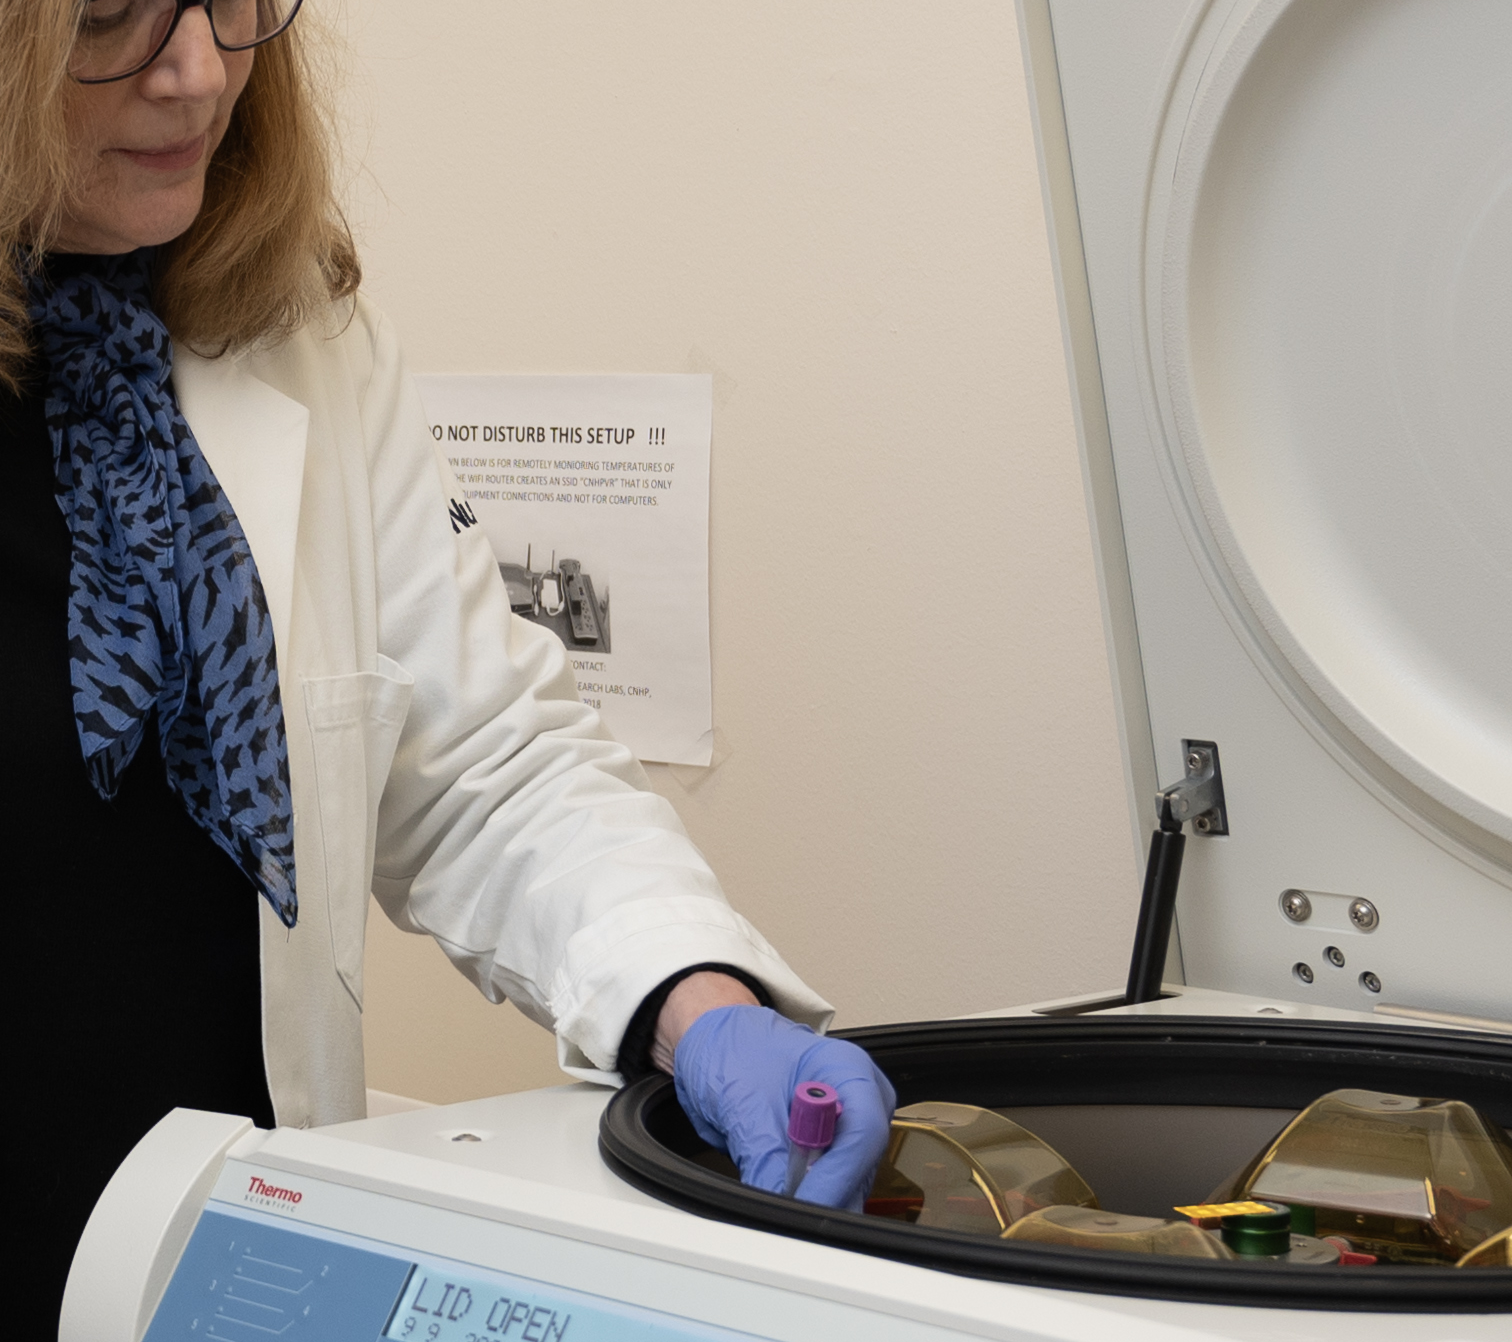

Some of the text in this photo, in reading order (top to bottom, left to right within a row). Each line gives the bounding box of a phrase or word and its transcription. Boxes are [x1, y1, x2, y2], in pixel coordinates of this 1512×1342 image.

[429, 425, 666, 445] O NOT DISTURB THIS SETUP !!!
[461, 458, 486, 467] BELOW
[489, 458, 495, 467] IS
[497, 459, 511, 468] FOR
[513, 459, 552, 470] REMOTELY
[602, 461, 662, 472] TEMPERATURES
[664, 463, 675, 473] OF
[468, 474, 484, 483] WIFI
[486, 475, 515, 485] ROUTER
[516, 475, 548, 485] CREATES
[549, 476, 560, 486] AN
[562, 476, 578, 486] SSID
[620, 478, 640, 488] THAT
[642, 479, 649, 488] IS
[651, 479, 672, 490] ONLY
[502, 491, 554, 502] CONNECTIONS
[556, 493, 572, 503] AND
[574, 494, 590, 503] NOT
[592, 494, 607, 504] FOR
[609, 495, 659, 506] COMPUTERS.
[571, 660, 606, 672] ONTACT:
[577, 681, 652, 698] EARCH LABS, CNHP,
[248, 1176, 303, 1204] Thermo
[244, 1194, 296, 1213] SCIENTIFIC
[321, 1265, 329, 1277] 2
[209, 1279, 217, 1291] 3
[411, 1277, 473, 1321] LID
[303, 1305, 310, 1315] 4
[191, 1318, 199, 1330] 5
